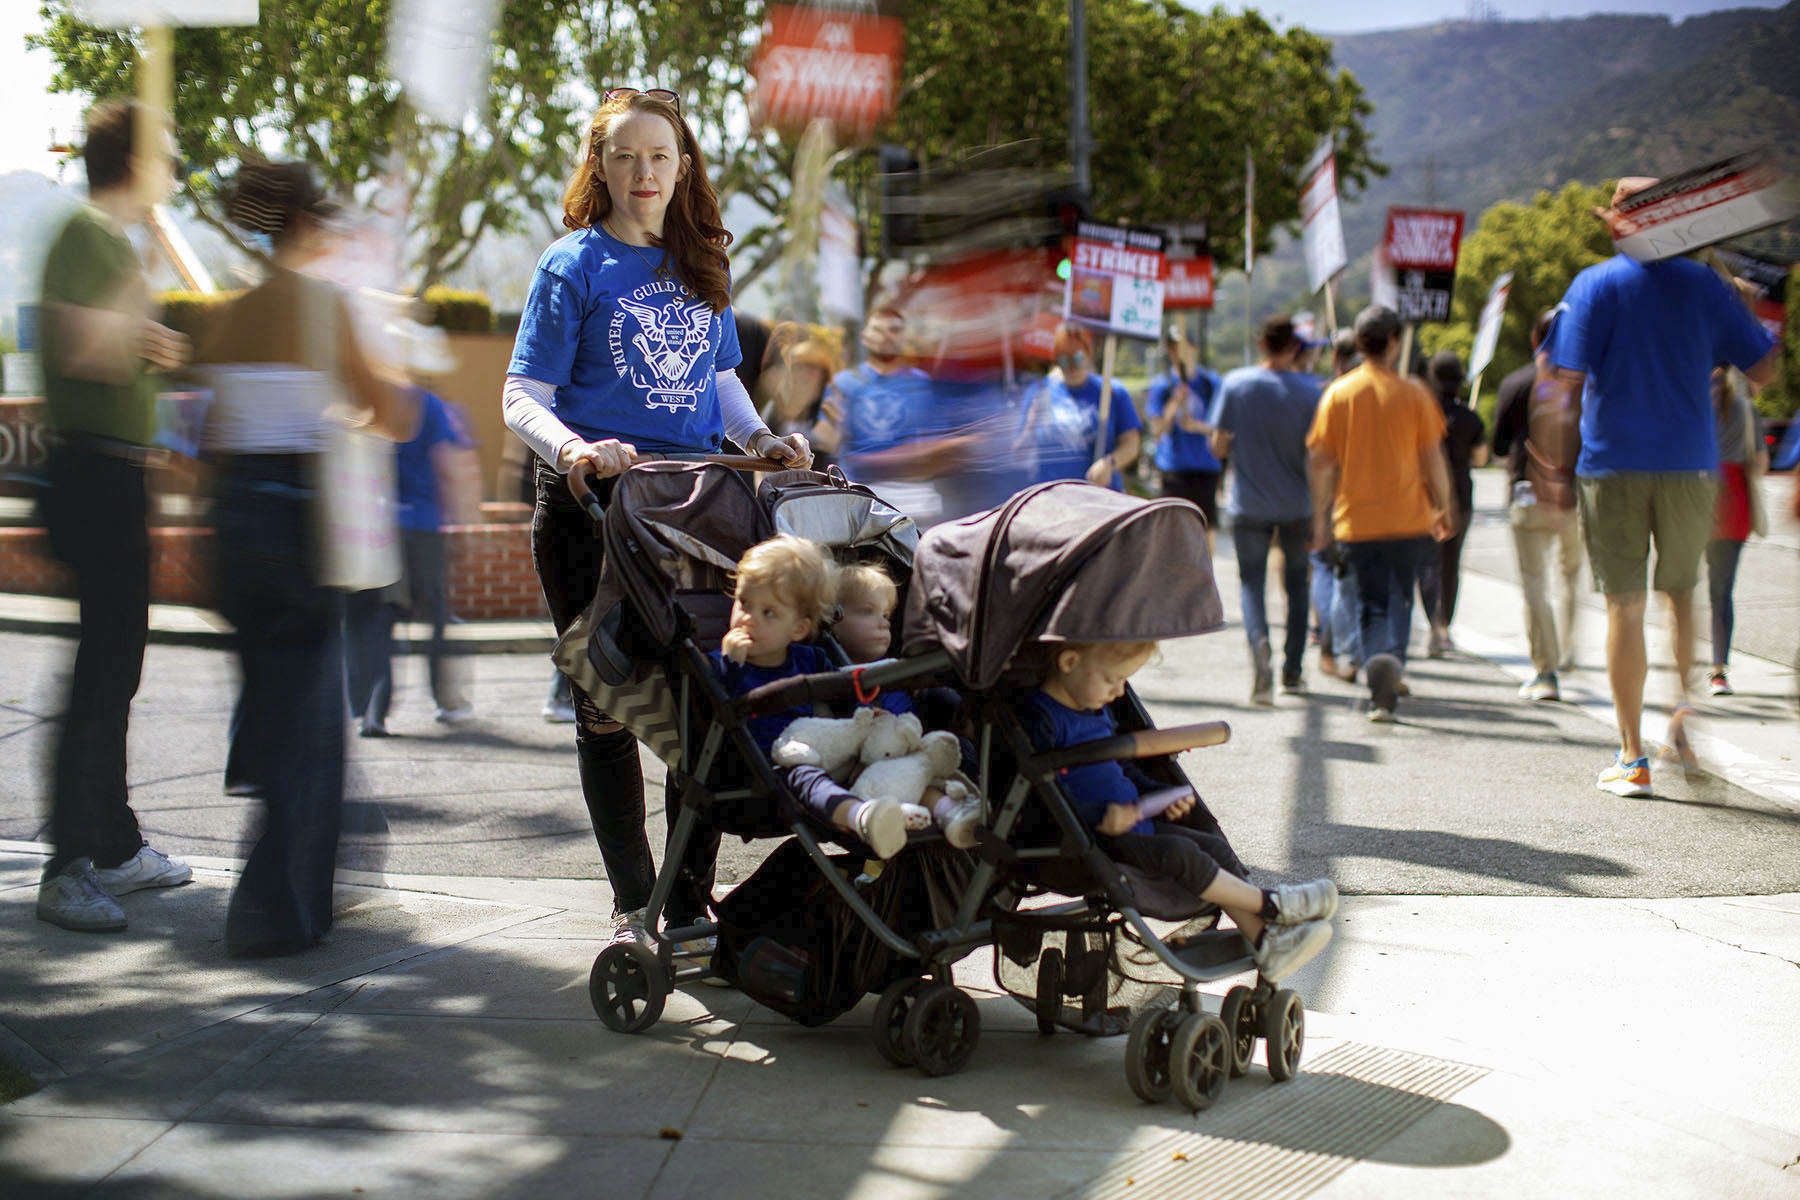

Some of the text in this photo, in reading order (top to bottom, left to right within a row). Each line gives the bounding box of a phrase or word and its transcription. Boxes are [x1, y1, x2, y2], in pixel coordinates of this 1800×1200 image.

[1075, 242, 1160, 278] STRIKE!
[608, 310, 629, 379] WRITERS
[632, 281, 676, 302] GUILD
[666, 328, 684, 336] united
[660, 394, 687, 404] WEST
